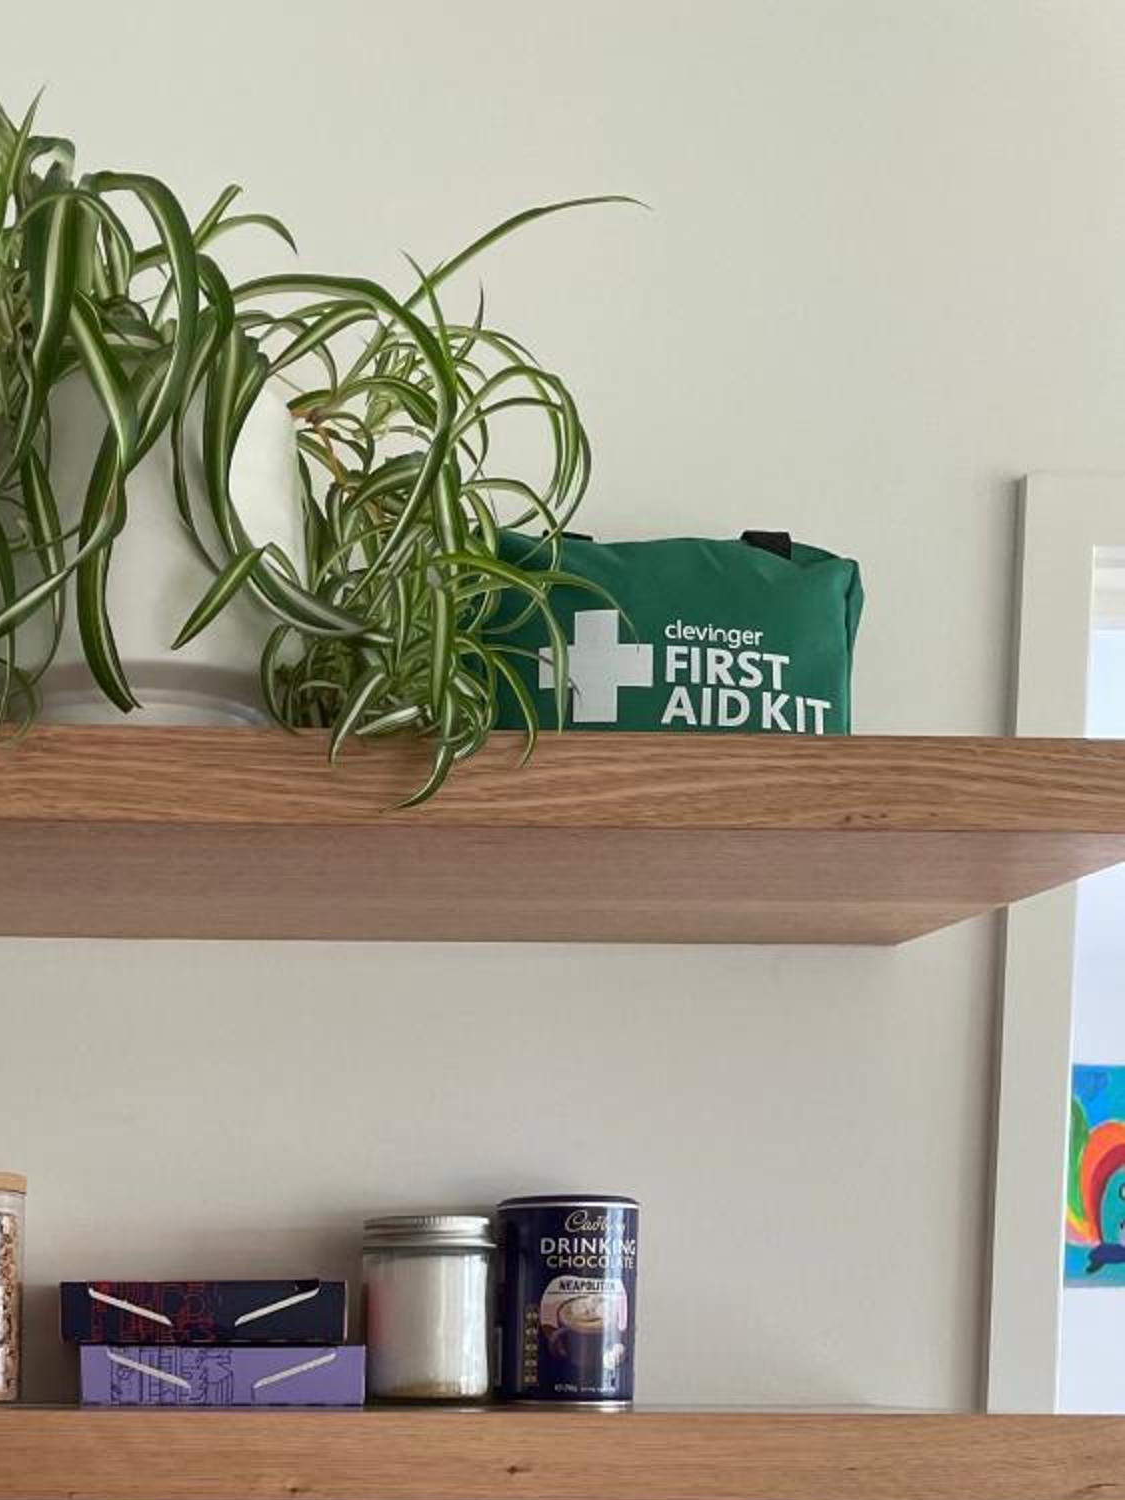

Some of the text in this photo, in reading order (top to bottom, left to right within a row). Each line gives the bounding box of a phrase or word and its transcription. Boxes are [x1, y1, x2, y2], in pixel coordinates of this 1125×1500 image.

[664, 619, 764, 648] clevinger
[665, 645, 790, 691] FIRST
[660, 686, 832, 735] AID KIT
[540, 1237, 636, 1255] DRINKING
